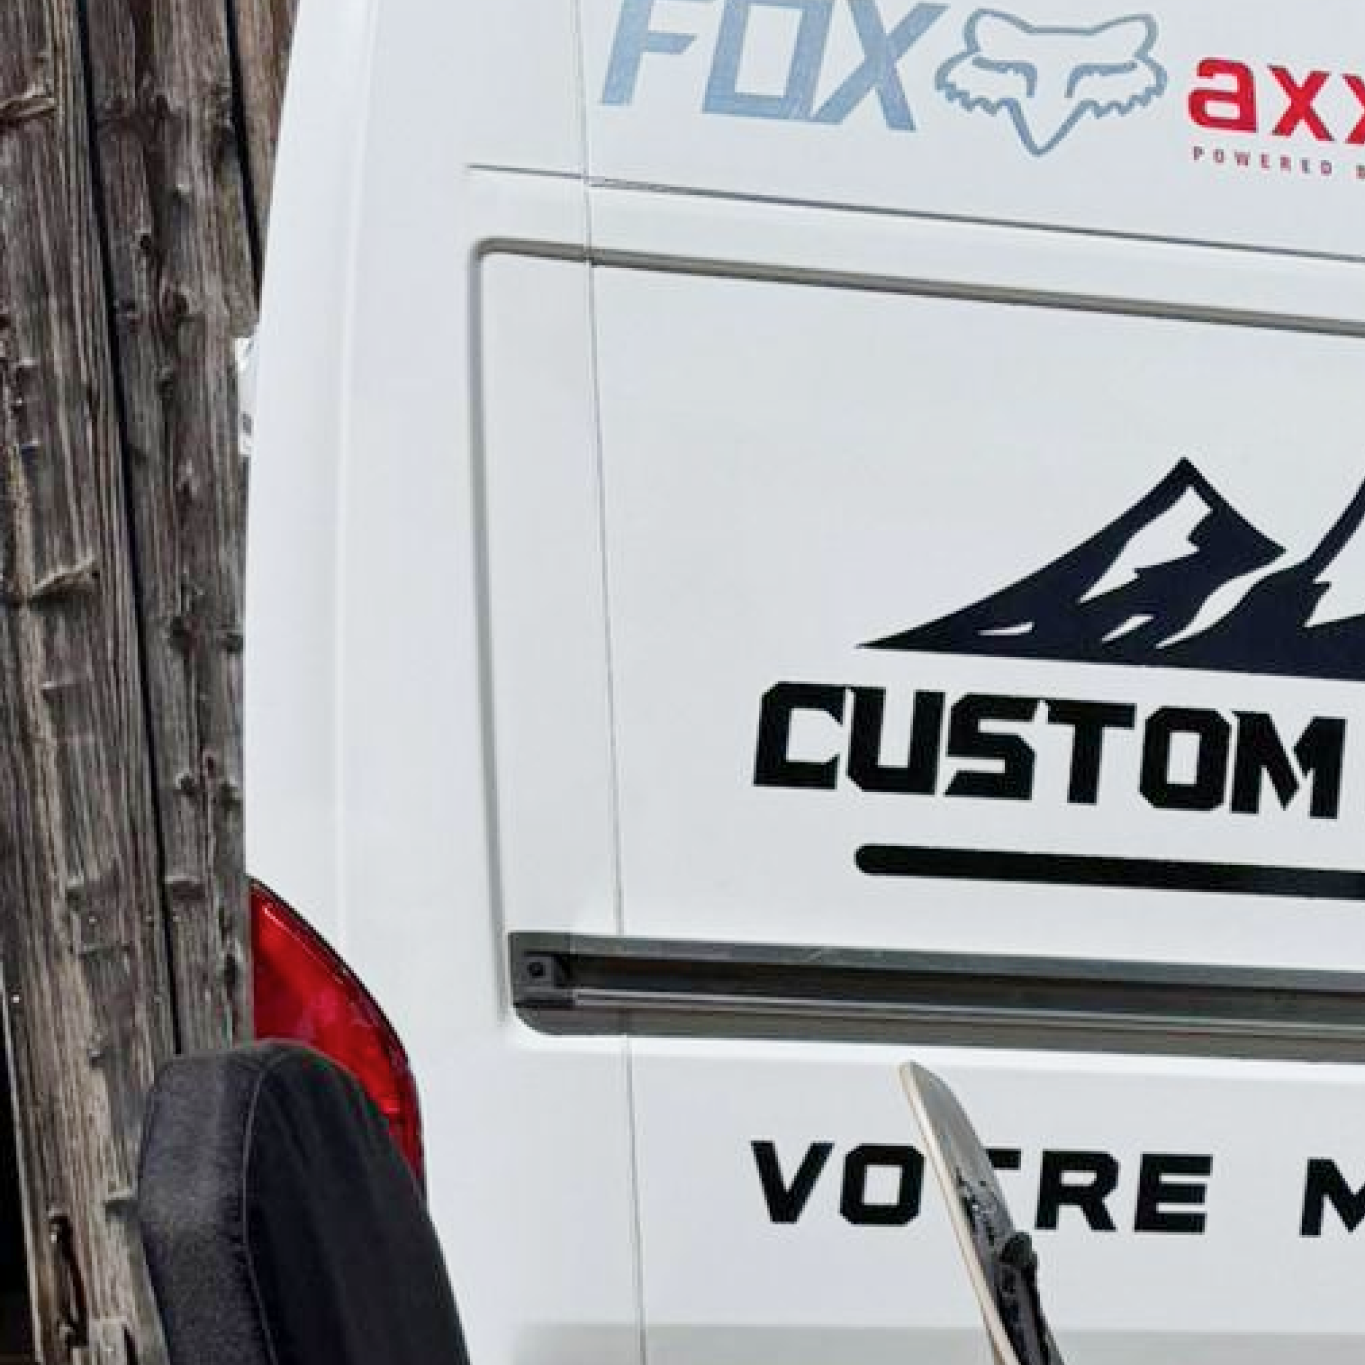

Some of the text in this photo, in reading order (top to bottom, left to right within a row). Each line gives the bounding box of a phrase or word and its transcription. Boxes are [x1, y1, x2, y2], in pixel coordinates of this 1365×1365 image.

[599, 0, 949, 132] FOX
[1192, 145, 1333, 176] POWERED
[753, 680, 1346, 820] CUSTOM
